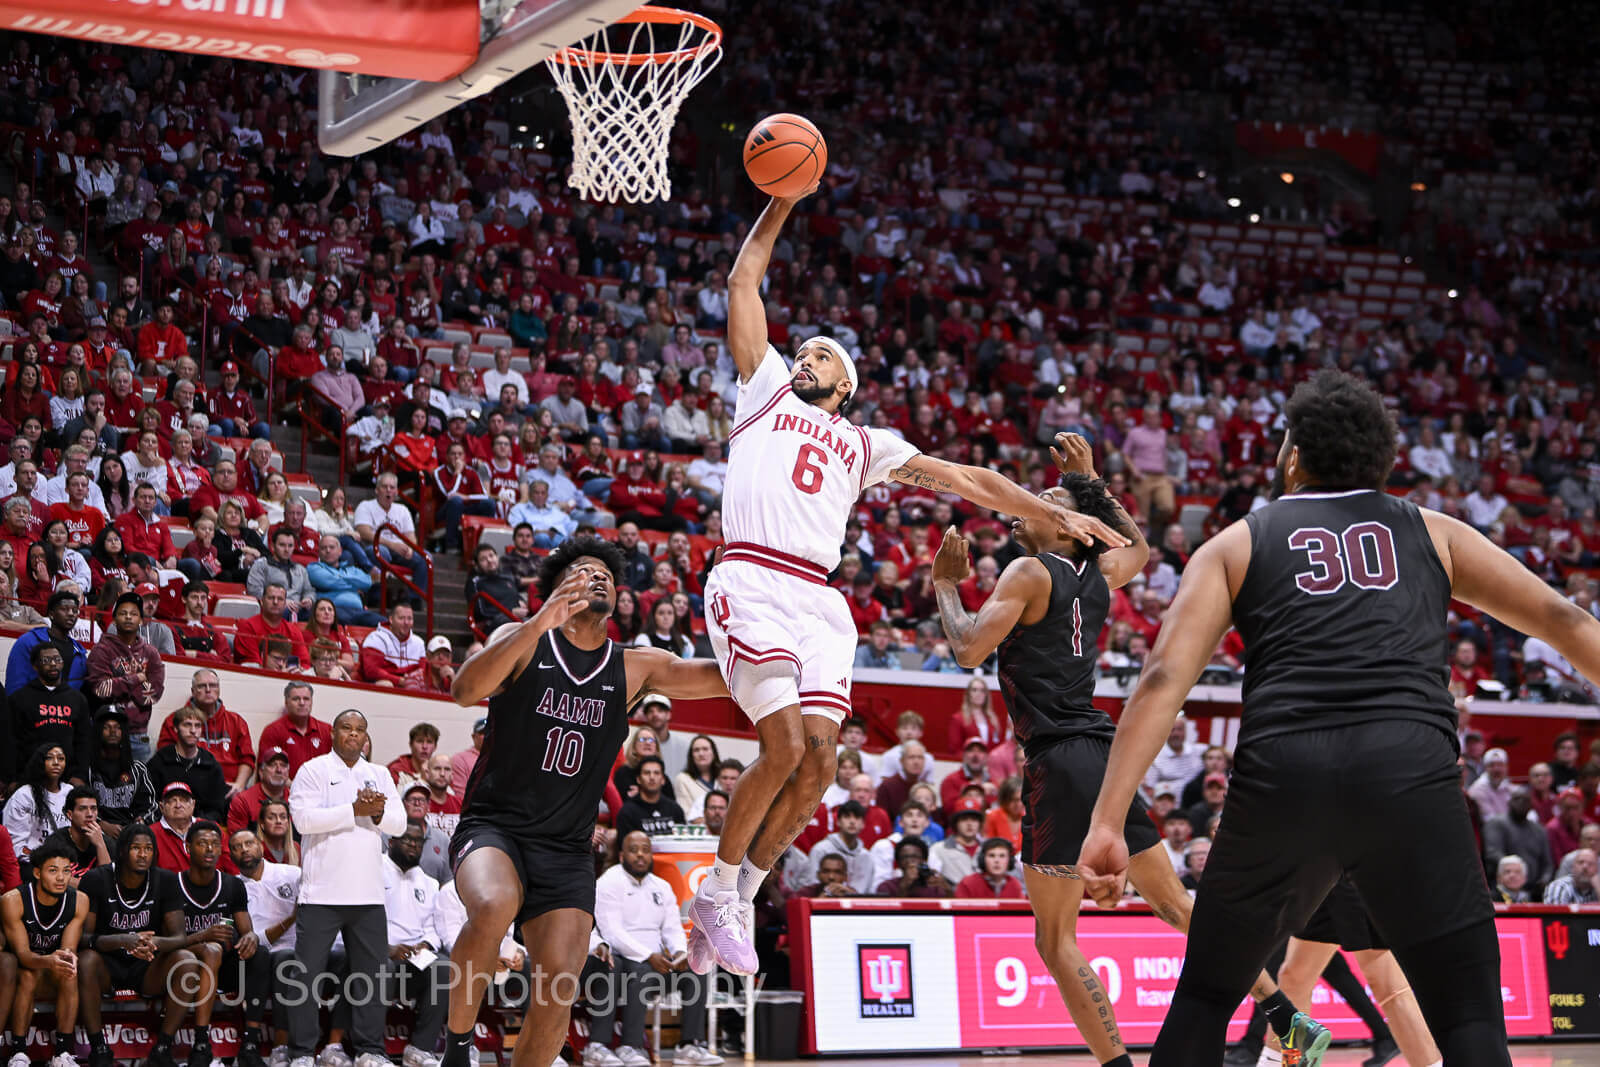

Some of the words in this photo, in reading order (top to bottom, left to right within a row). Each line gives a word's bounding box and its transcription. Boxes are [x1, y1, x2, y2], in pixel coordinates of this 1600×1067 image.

[772, 413, 856, 474] INDIANA
[791, 442, 828, 495] 6
[65, 518, 89, 532] Reds
[1288, 521, 1398, 595] 30
[1072, 597, 1082, 657] 1
[40, 704, 71, 717] SOLO
[536, 687, 605, 727] AAMU
[542, 726, 585, 777] 10
[109, 910, 150, 929] AAMU
[994, 957, 1028, 1007] 9
[1134, 957, 1184, 979] INDI
[863, 1003, 913, 1015] HEALTH
[1136, 986, 1175, 1007] hav
[1549, 993, 1585, 1007] FOULS
